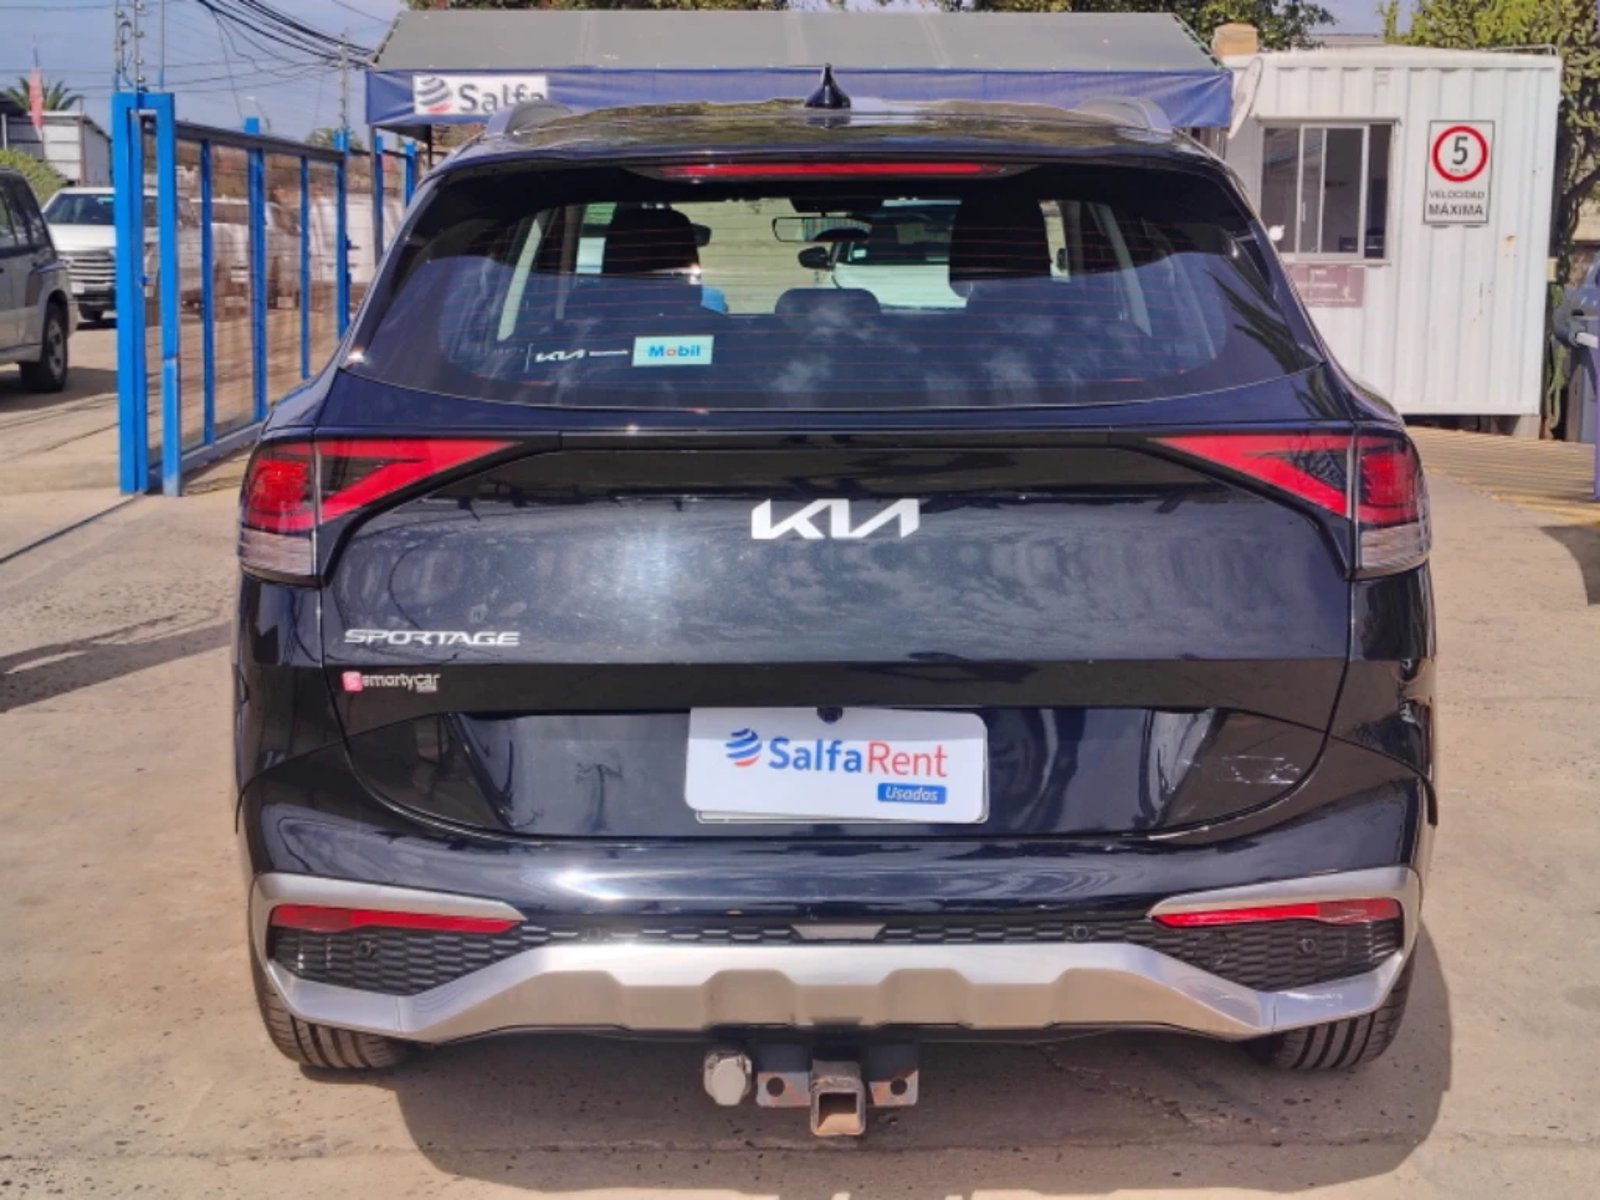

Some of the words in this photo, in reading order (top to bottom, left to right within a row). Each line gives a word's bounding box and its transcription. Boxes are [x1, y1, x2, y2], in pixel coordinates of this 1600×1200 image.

[1452, 136, 1468, 165] 5
[1429, 190, 1485, 199] VELOCIDAD
[1429, 202, 1483, 215] MÁXIMA
[648, 345, 700, 358] Mobil
[751, 498, 921, 540] KIA
[344, 629, 520, 647] SPORTAGE
[885, 786, 938, 802] Usados
